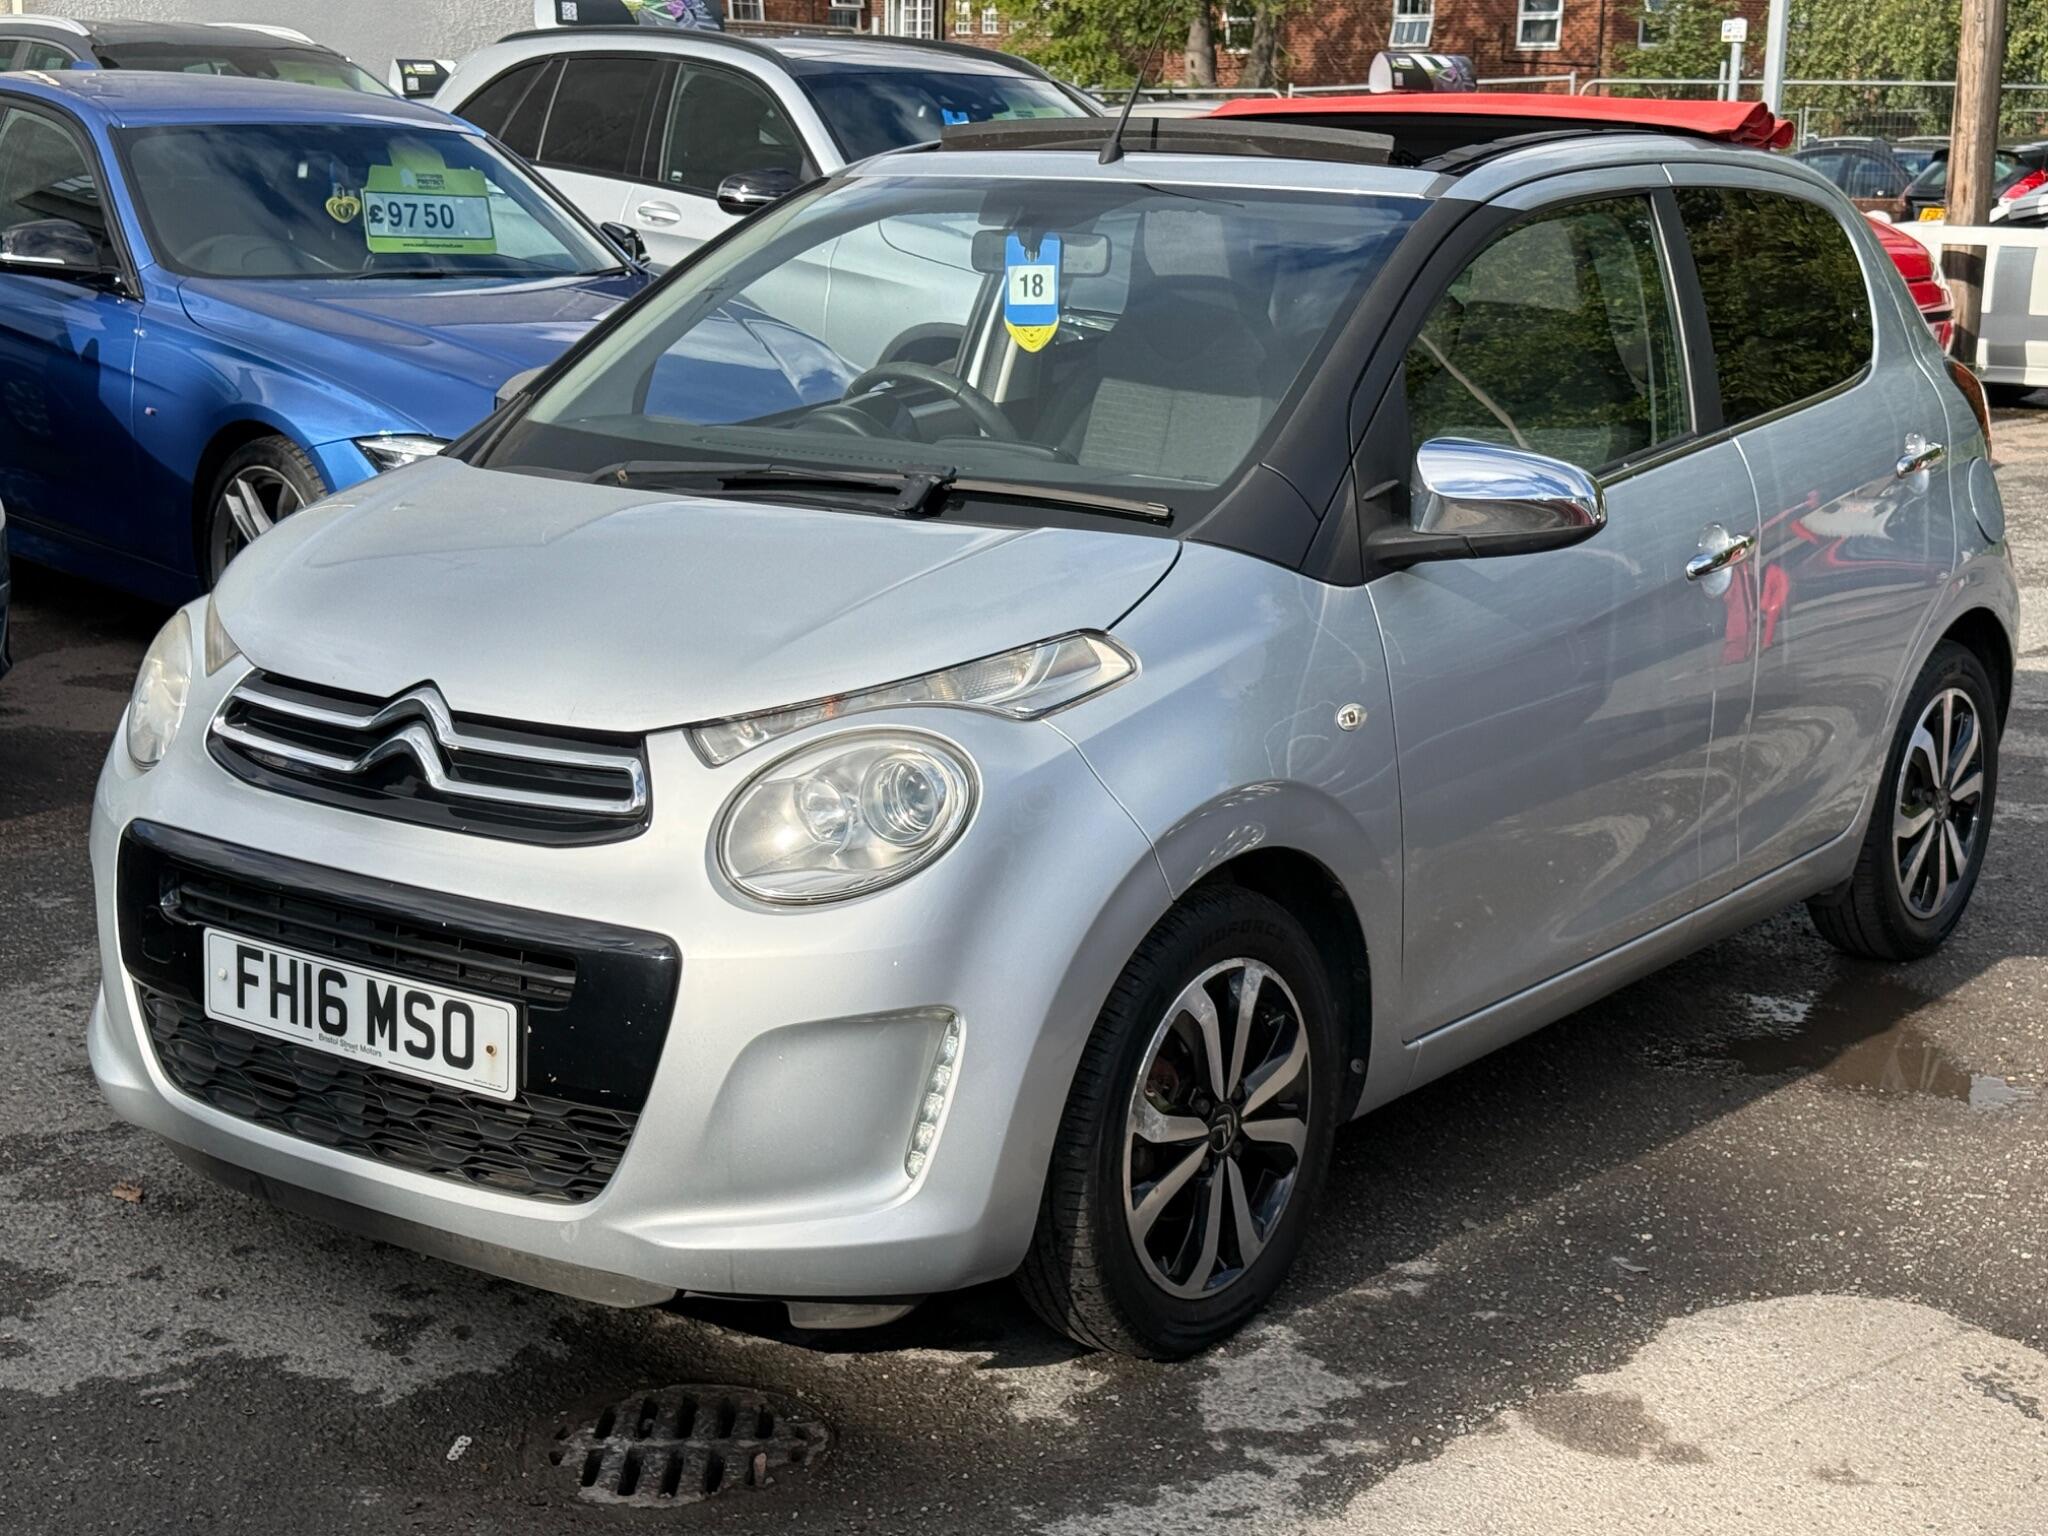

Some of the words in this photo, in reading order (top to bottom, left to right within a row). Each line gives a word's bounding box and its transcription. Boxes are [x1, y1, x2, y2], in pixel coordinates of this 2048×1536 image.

[369, 201, 455, 229] £9750
[1019, 273, 1044, 298] 18
[236, 944, 348, 1038] FH16
[366, 979, 475, 1071] MSO
[318, 1032, 338, 1045] Bristol
[340, 1038, 358, 1051] Street
[360, 1044, 382, 1057] Motors
